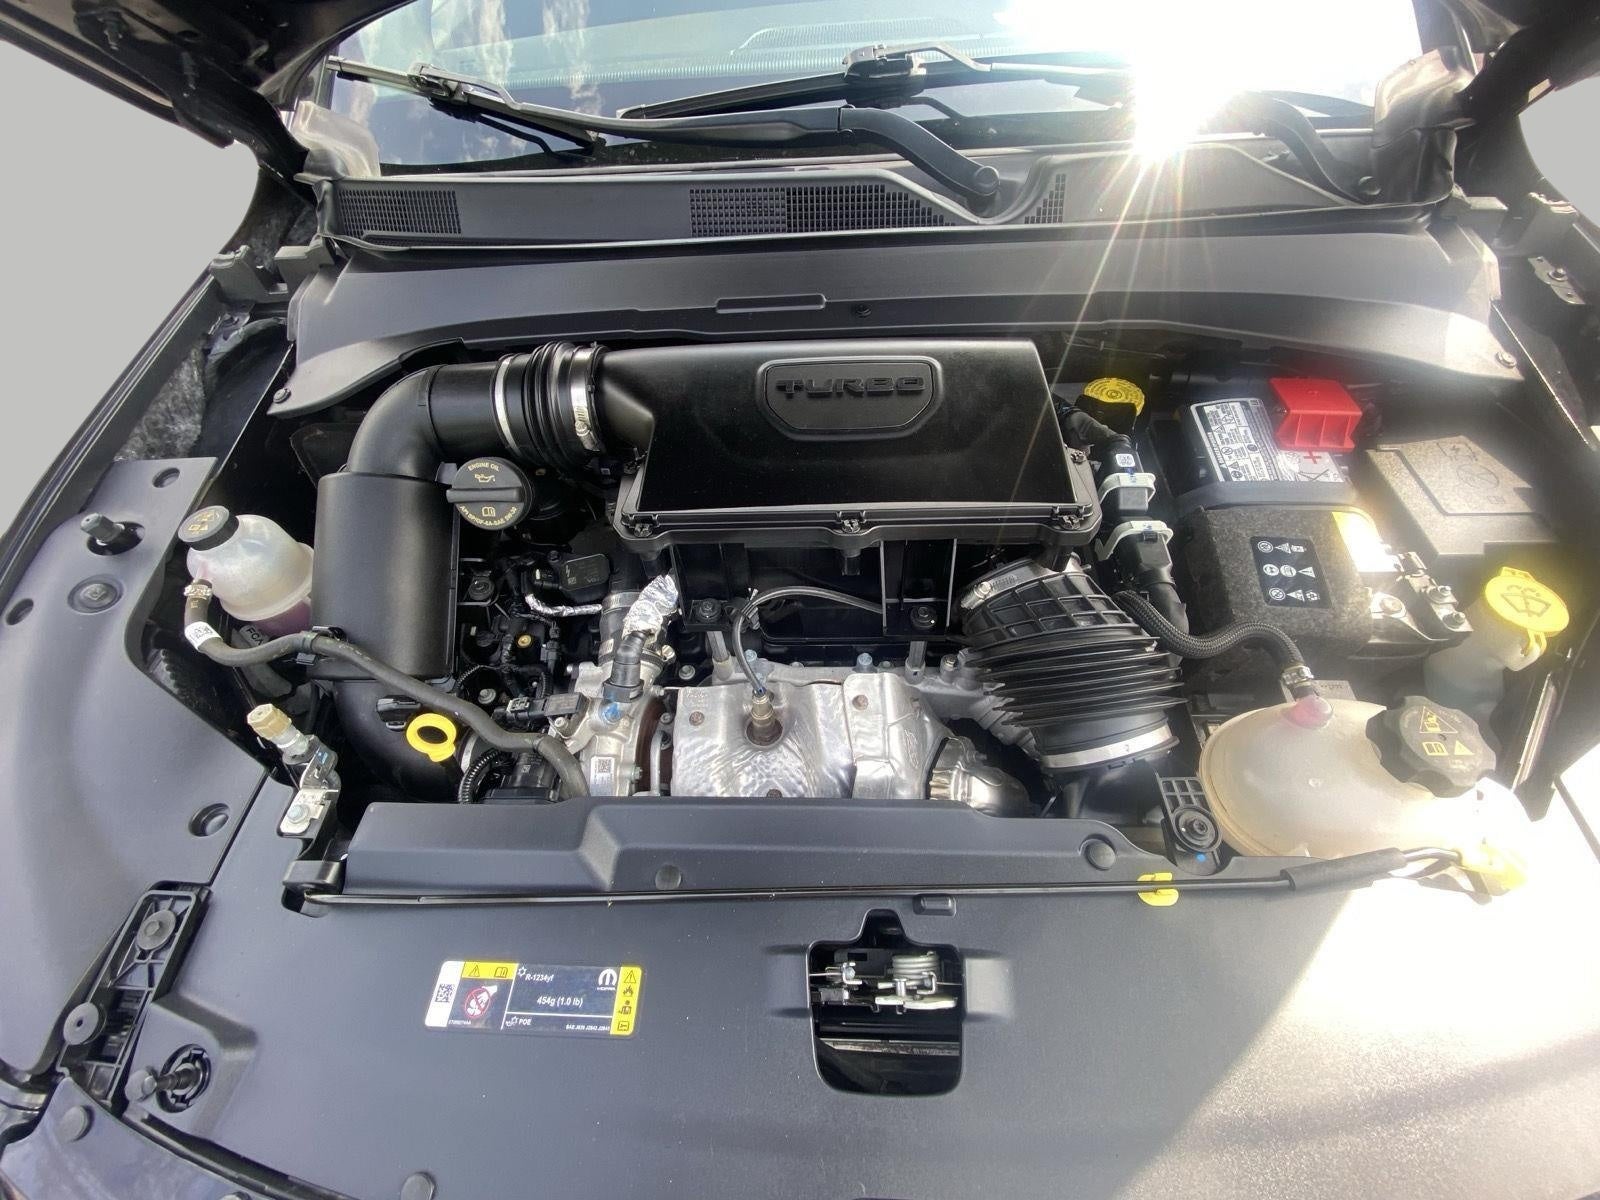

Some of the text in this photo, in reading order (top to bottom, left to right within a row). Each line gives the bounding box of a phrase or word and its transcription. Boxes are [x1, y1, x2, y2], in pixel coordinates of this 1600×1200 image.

[775, 377, 926, 398] TURBO
[467, 462, 500, 472] ENGINE OIL
[525, 973, 555, 983] R-1234yf
[537, 996, 584, 1008] 454g (1.0 lb)
[518, 1018, 532, 1026] POE
